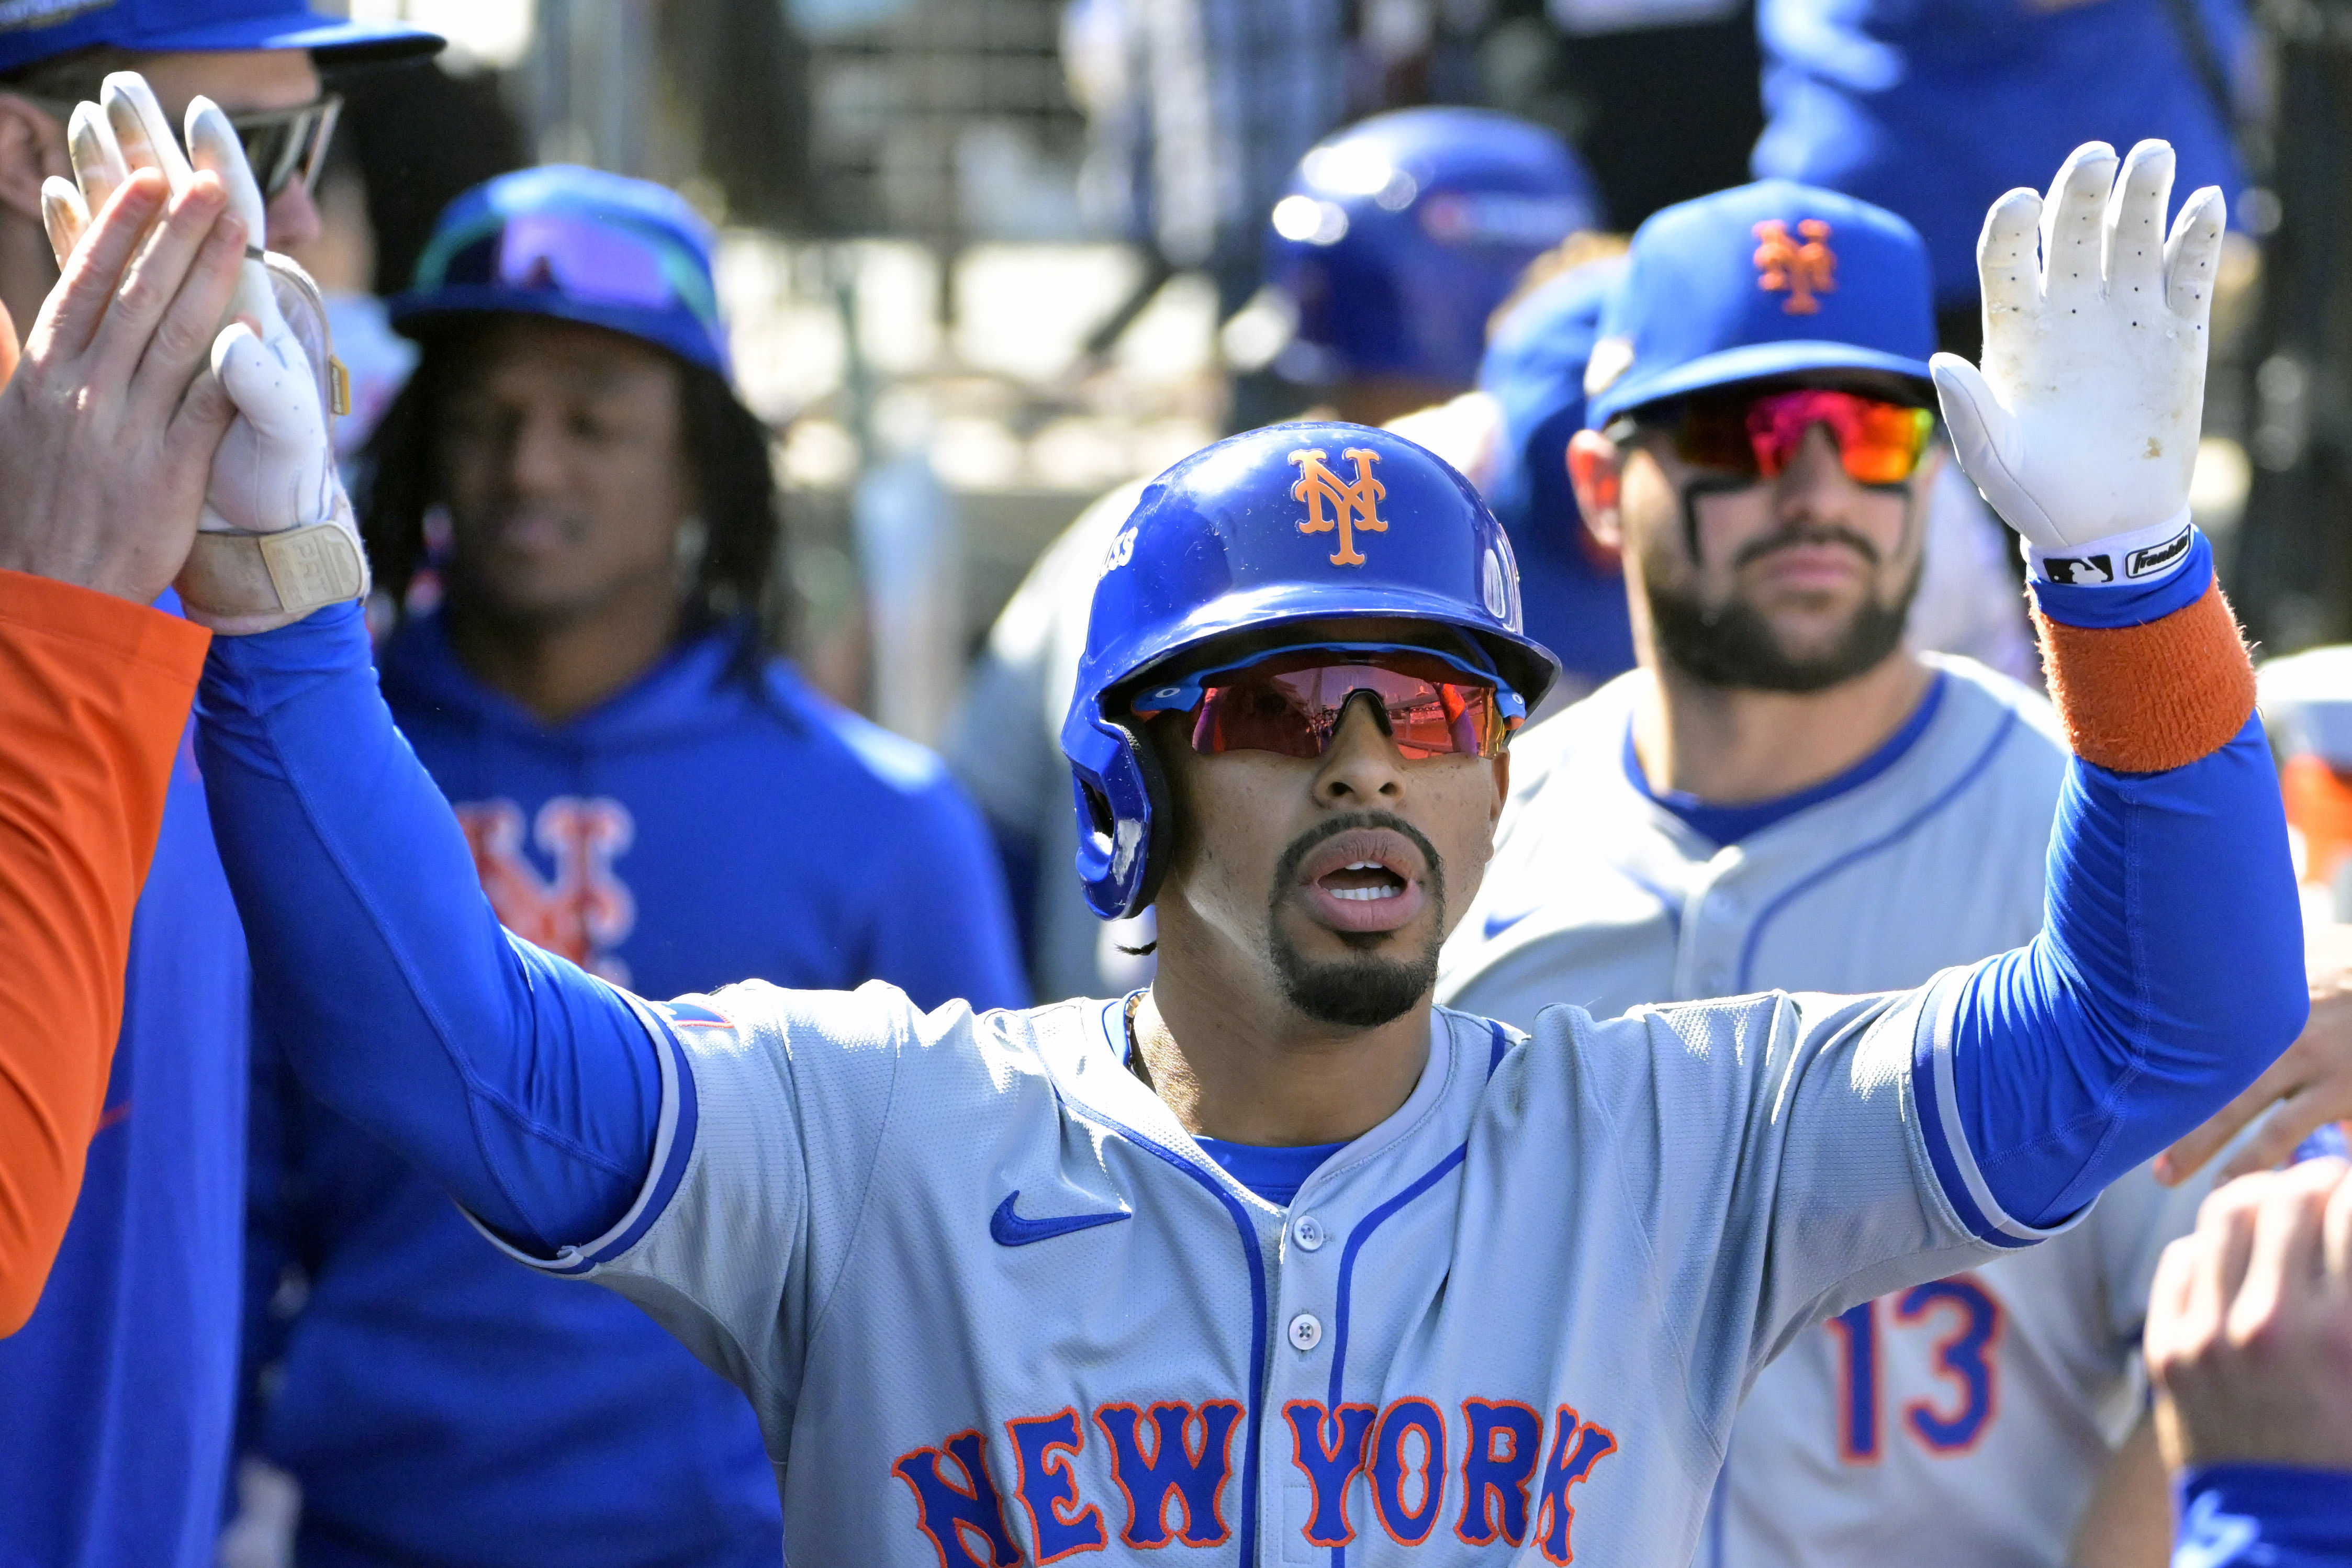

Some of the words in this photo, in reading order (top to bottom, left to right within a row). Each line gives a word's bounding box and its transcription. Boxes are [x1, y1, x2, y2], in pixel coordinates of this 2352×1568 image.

[1290, 448, 1388, 565] NY
[2133, 534, 2188, 574] Franklin
[1824, 1271, 2006, 1465] 13
[891, 1399, 1246, 1568] NEW
[1282, 1397, 1618, 1567] YORK
